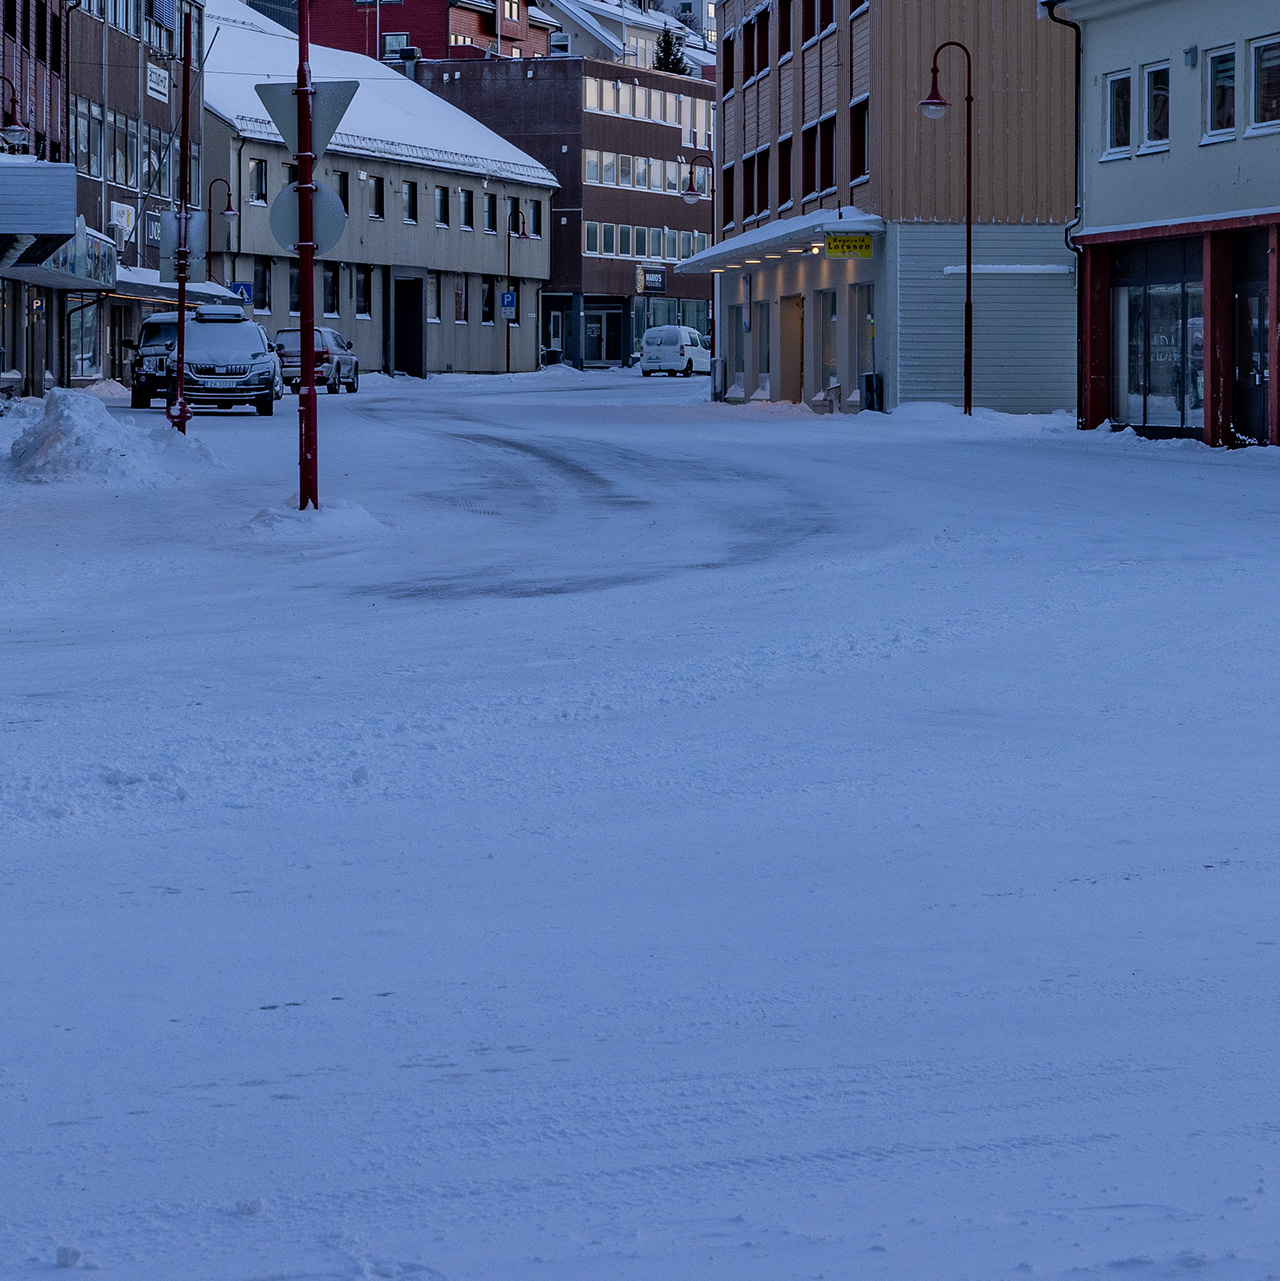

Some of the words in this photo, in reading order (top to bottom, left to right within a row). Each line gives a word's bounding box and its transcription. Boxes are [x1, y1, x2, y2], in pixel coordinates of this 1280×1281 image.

[828, 242, 870, 250] Larssen
[33, 299, 41, 310] P
[504, 294, 512, 306] P
